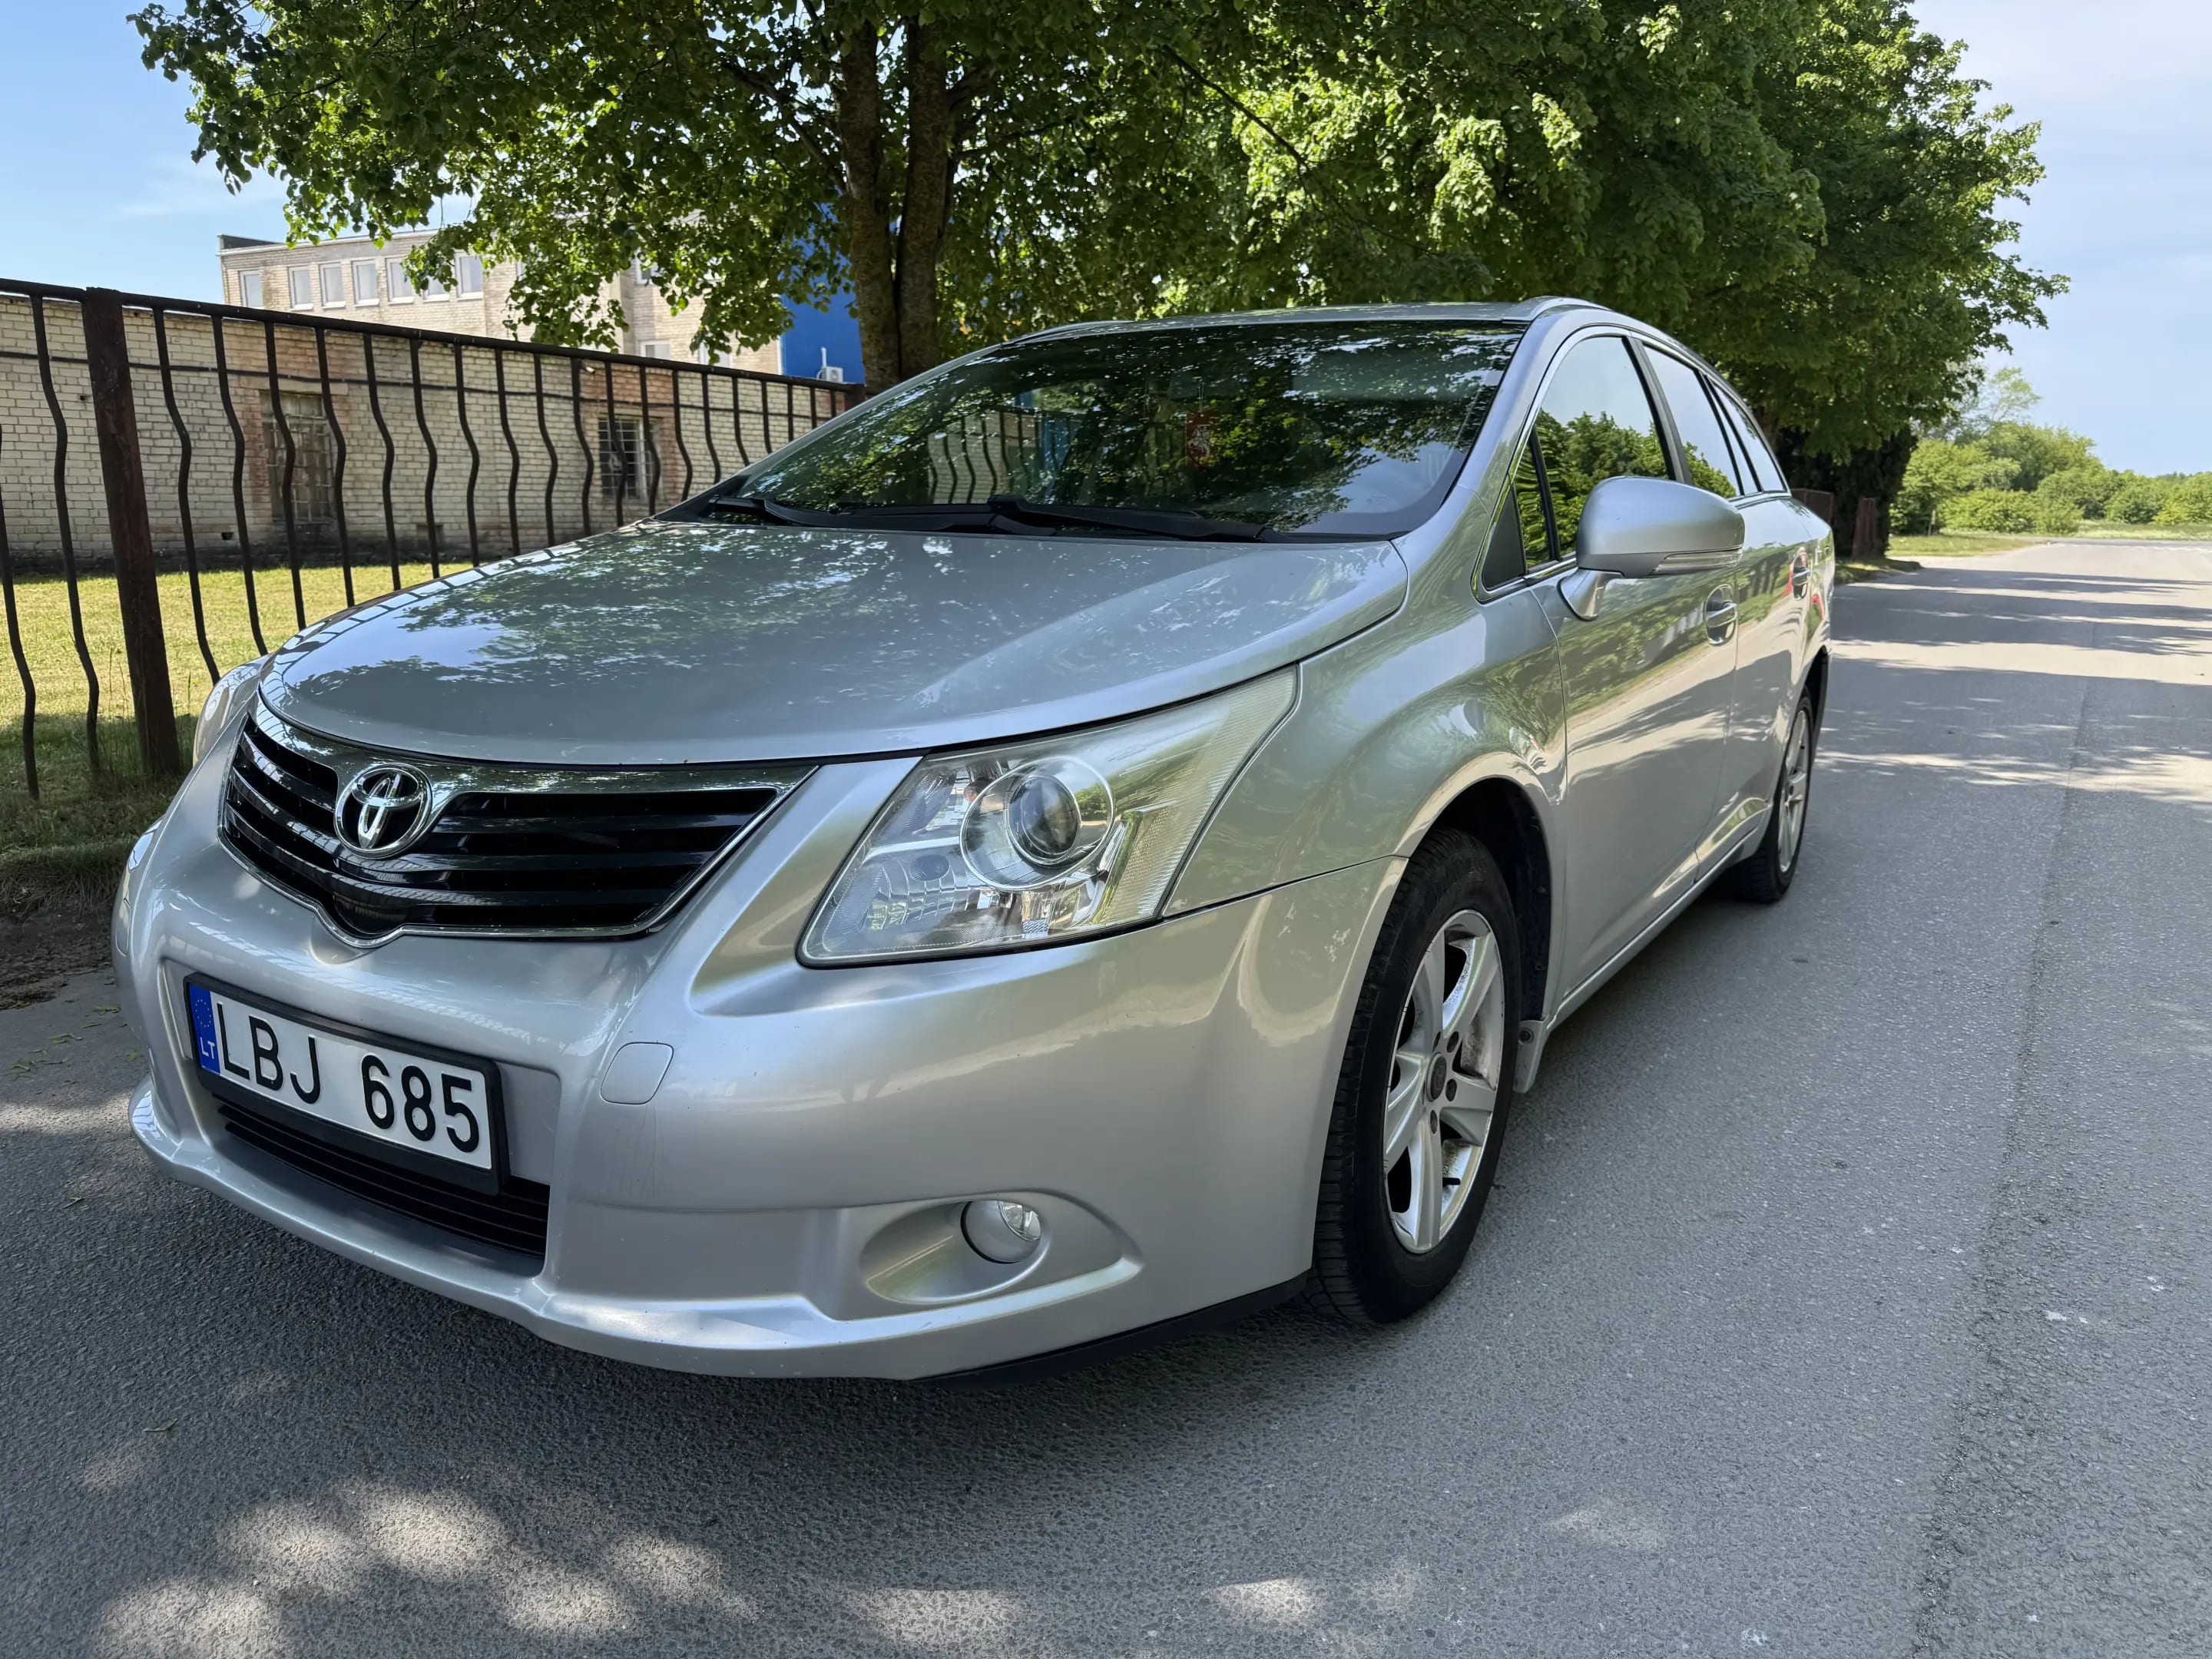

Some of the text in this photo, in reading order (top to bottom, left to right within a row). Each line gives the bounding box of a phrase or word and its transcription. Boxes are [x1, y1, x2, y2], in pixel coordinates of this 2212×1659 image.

[200, 1037, 215, 1060] LT
[217, 1002, 480, 1153] LBJ 685
